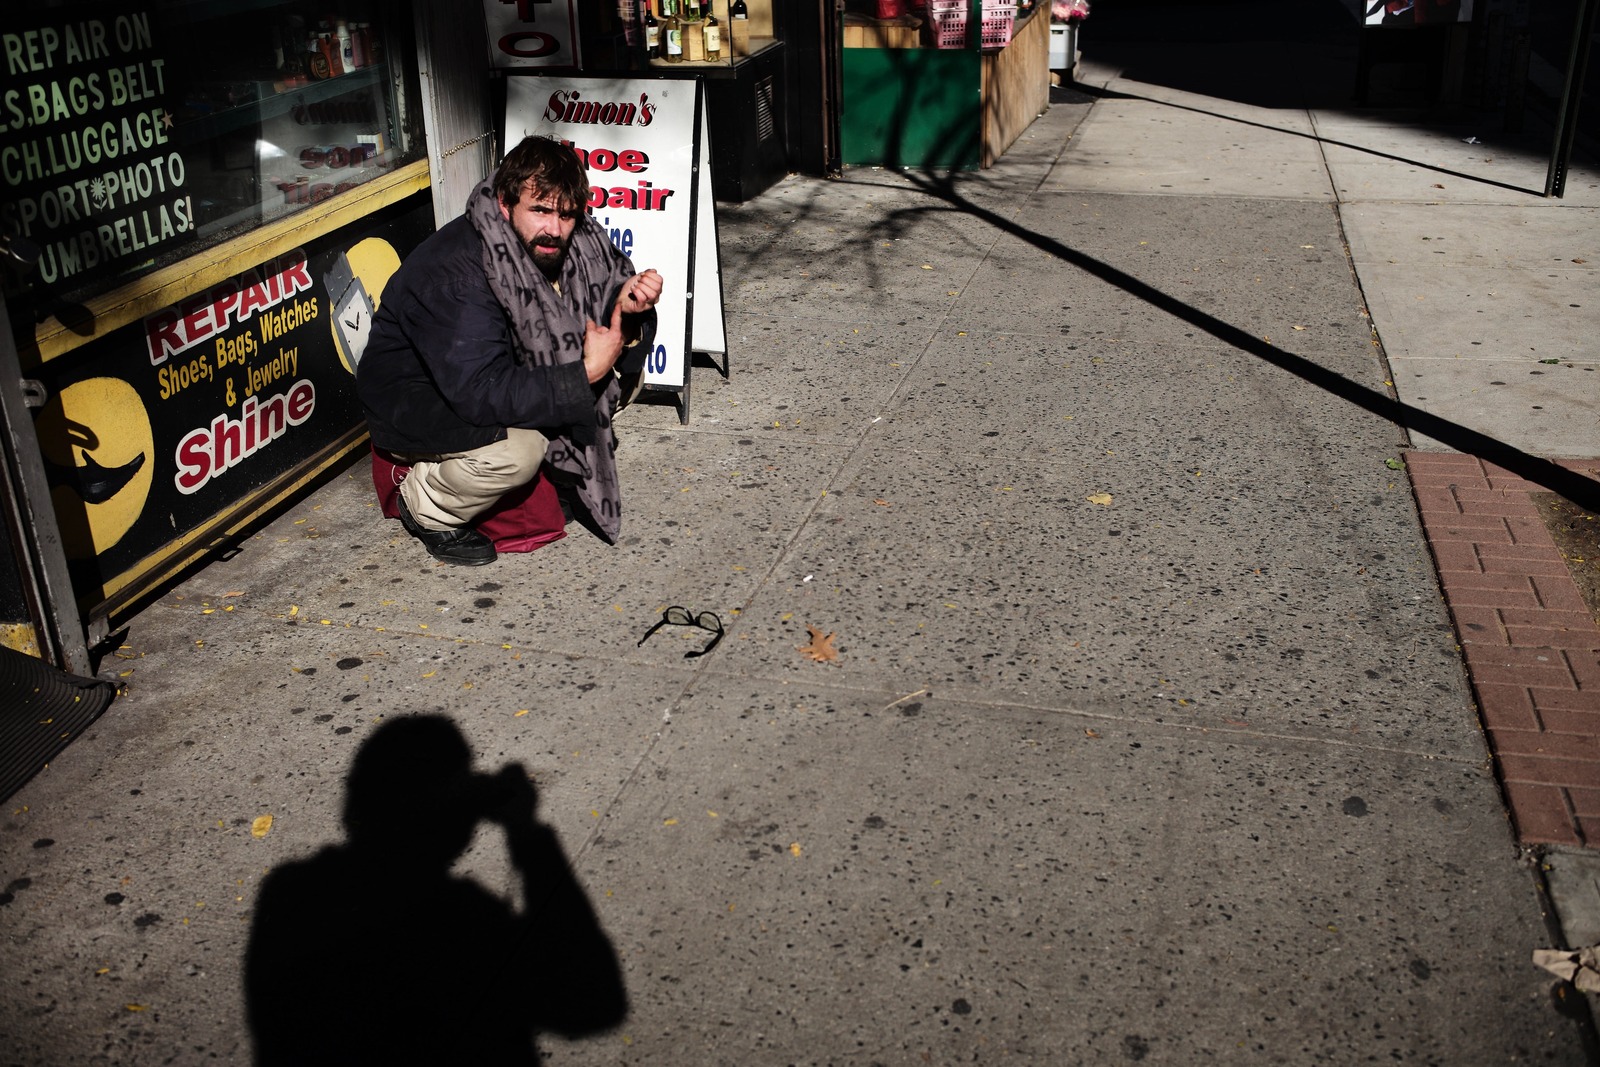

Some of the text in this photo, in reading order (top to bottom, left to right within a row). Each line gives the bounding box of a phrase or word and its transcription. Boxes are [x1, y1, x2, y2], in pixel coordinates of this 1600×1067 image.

[2, 12, 153, 76] REPAIR ON
[541, 89, 657, 127] Simon's
[103, 151, 185, 210] PHOTO
[561, 140, 649, 173] hoe
[584, 180, 675, 216] pair
[38, 195, 194, 284] UMBRELLAS!
[145, 247, 313, 366] REPAIR
[158, 297, 318, 400] Shoes, Bags, Watches
[225, 347, 298, 407] & Jewelry
[174, 378, 315, 495] Shine
